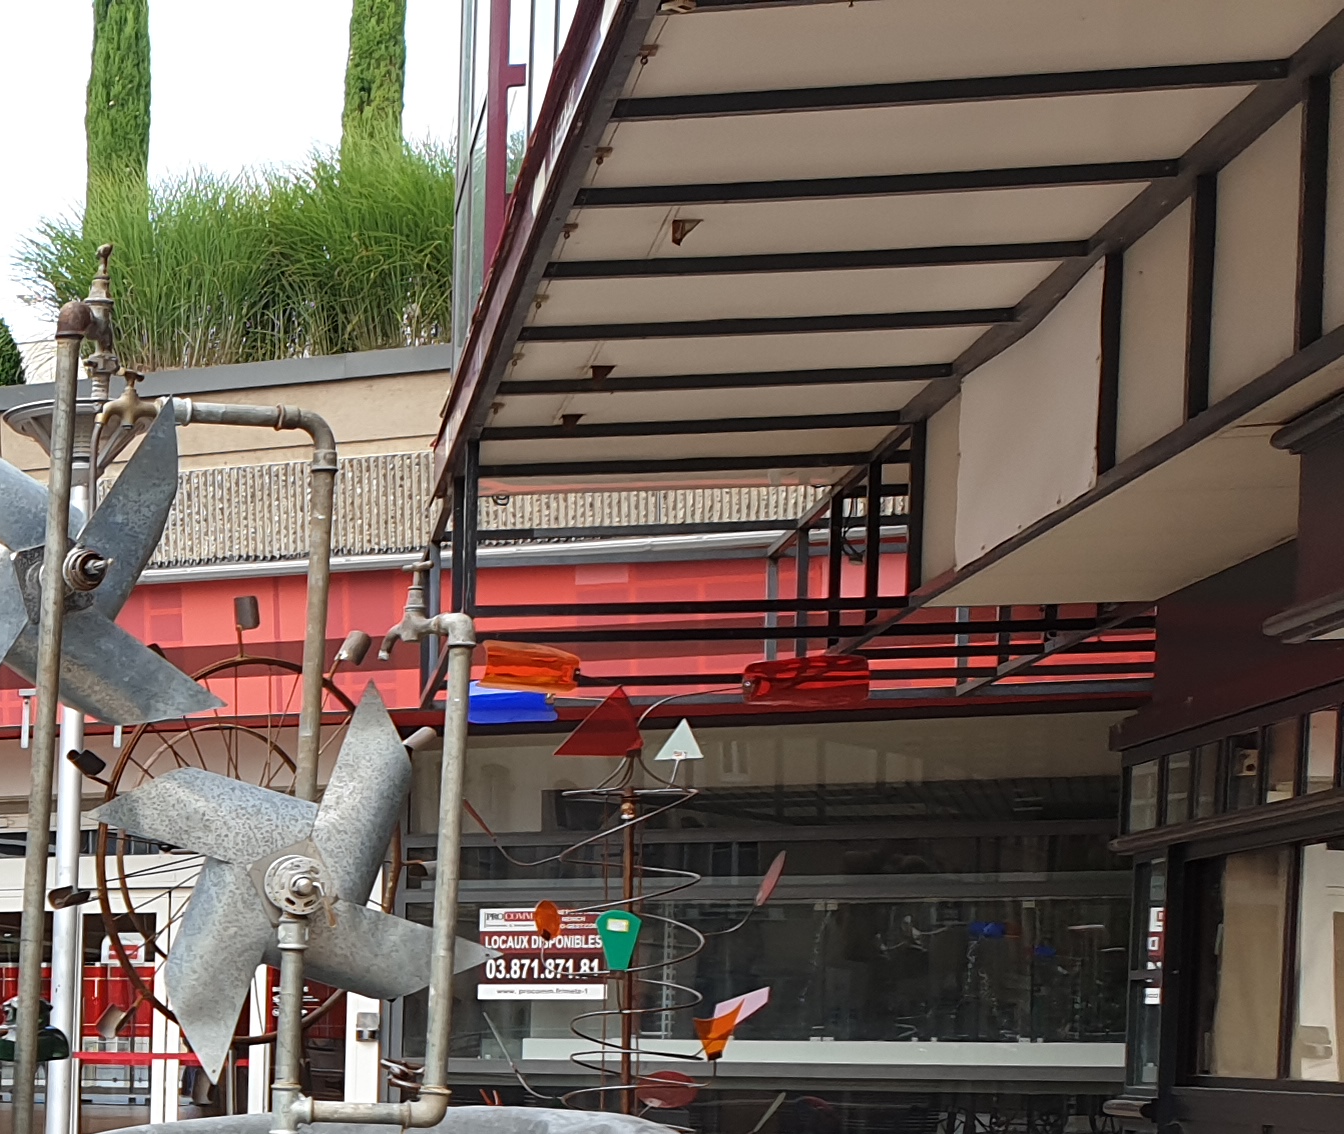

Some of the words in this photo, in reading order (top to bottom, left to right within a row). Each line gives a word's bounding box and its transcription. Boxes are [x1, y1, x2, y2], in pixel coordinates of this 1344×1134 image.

[485, 935, 529, 949] LOCAUX
[531, 935, 603, 949] DISPONIBLES
[485, 958, 600, 979] 03.871.871.81
